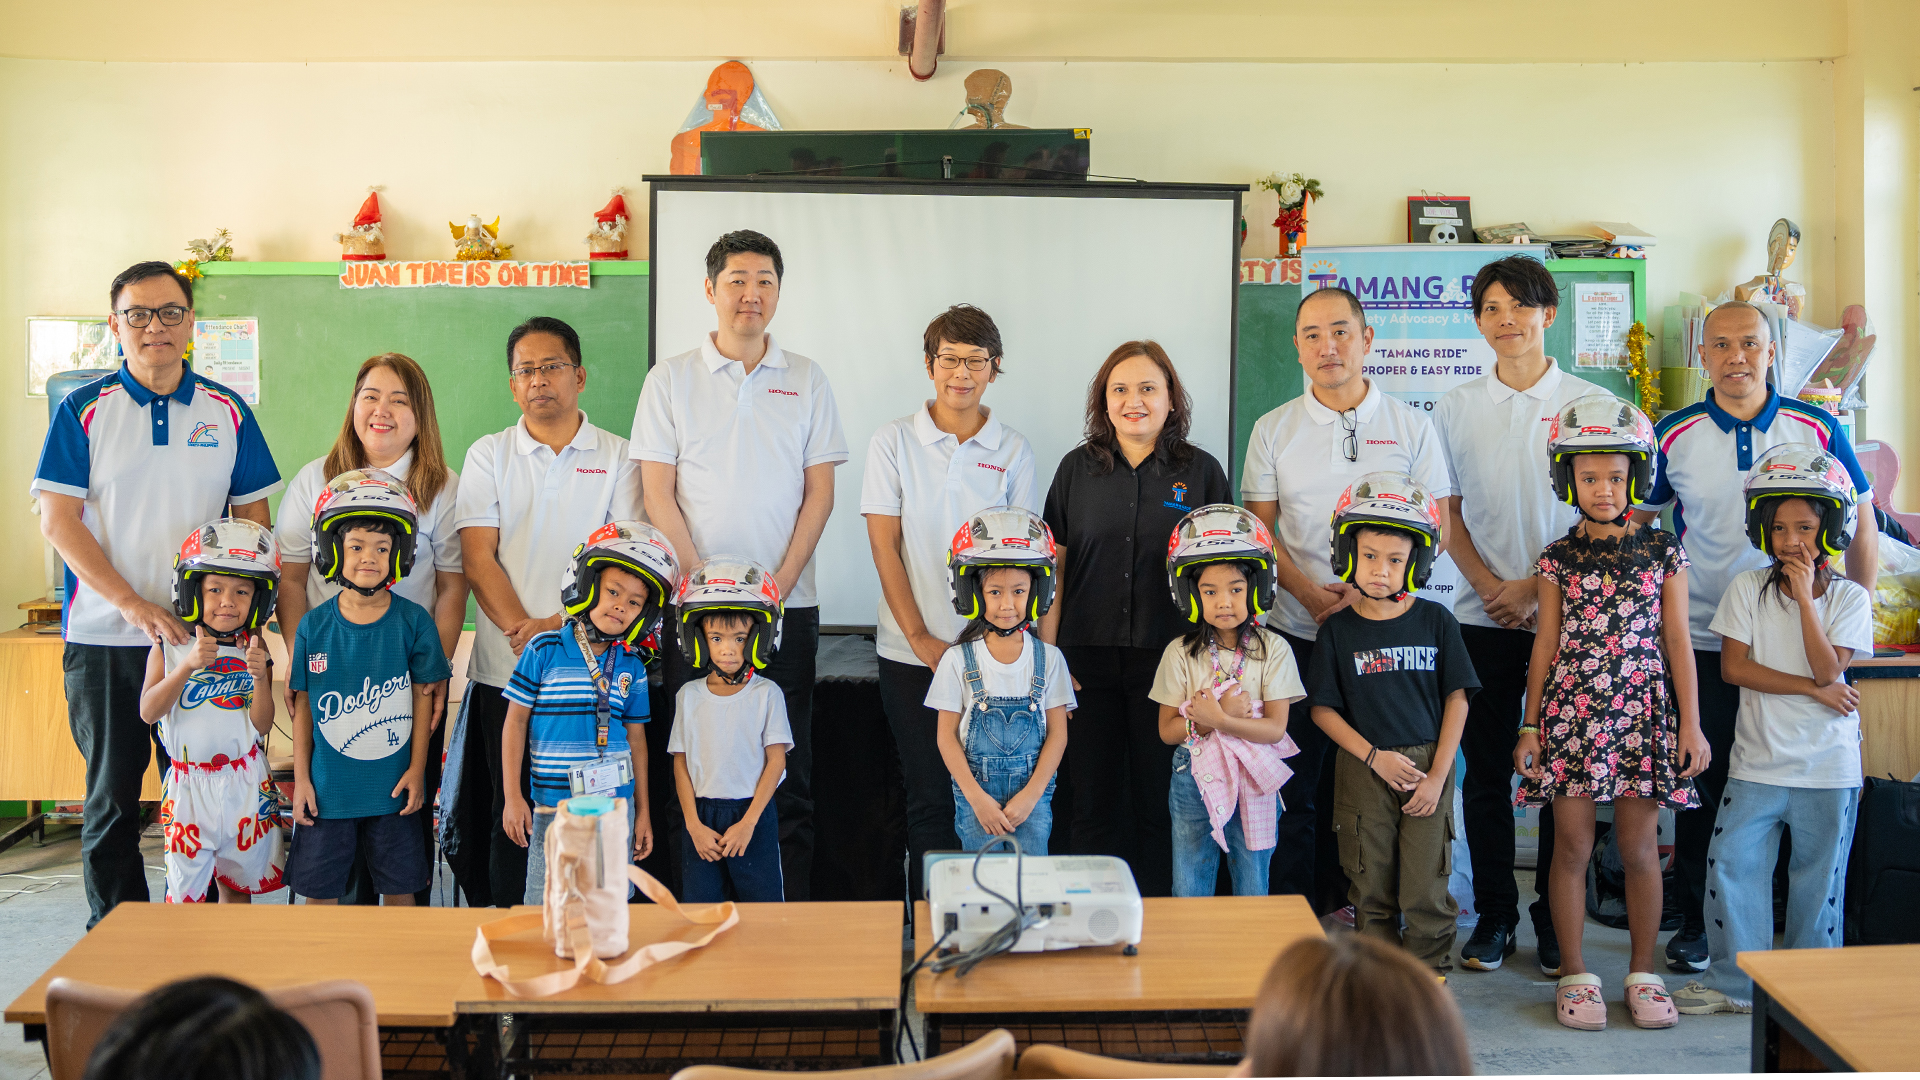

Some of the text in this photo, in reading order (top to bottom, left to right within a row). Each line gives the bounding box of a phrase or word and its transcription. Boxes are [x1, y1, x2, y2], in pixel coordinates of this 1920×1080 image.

[341, 261, 589, 287] JUAN TIME IS ON TIME
[1240, 259, 1302, 284] TY IS
[1308, 273, 1444, 300] TAMANG
[1389, 313, 1449, 326] Advocacy
[1452, 313, 1461, 324] &
[1361, 365, 1482, 375] PROPER & EASY RIDE
[768, 388, 800, 397] HONDA
[1434, 584, 1454, 594] app
[310, 660, 327, 673] NFL
[317, 670, 410, 725] Dodgers
[387, 728, 400, 747] LA
